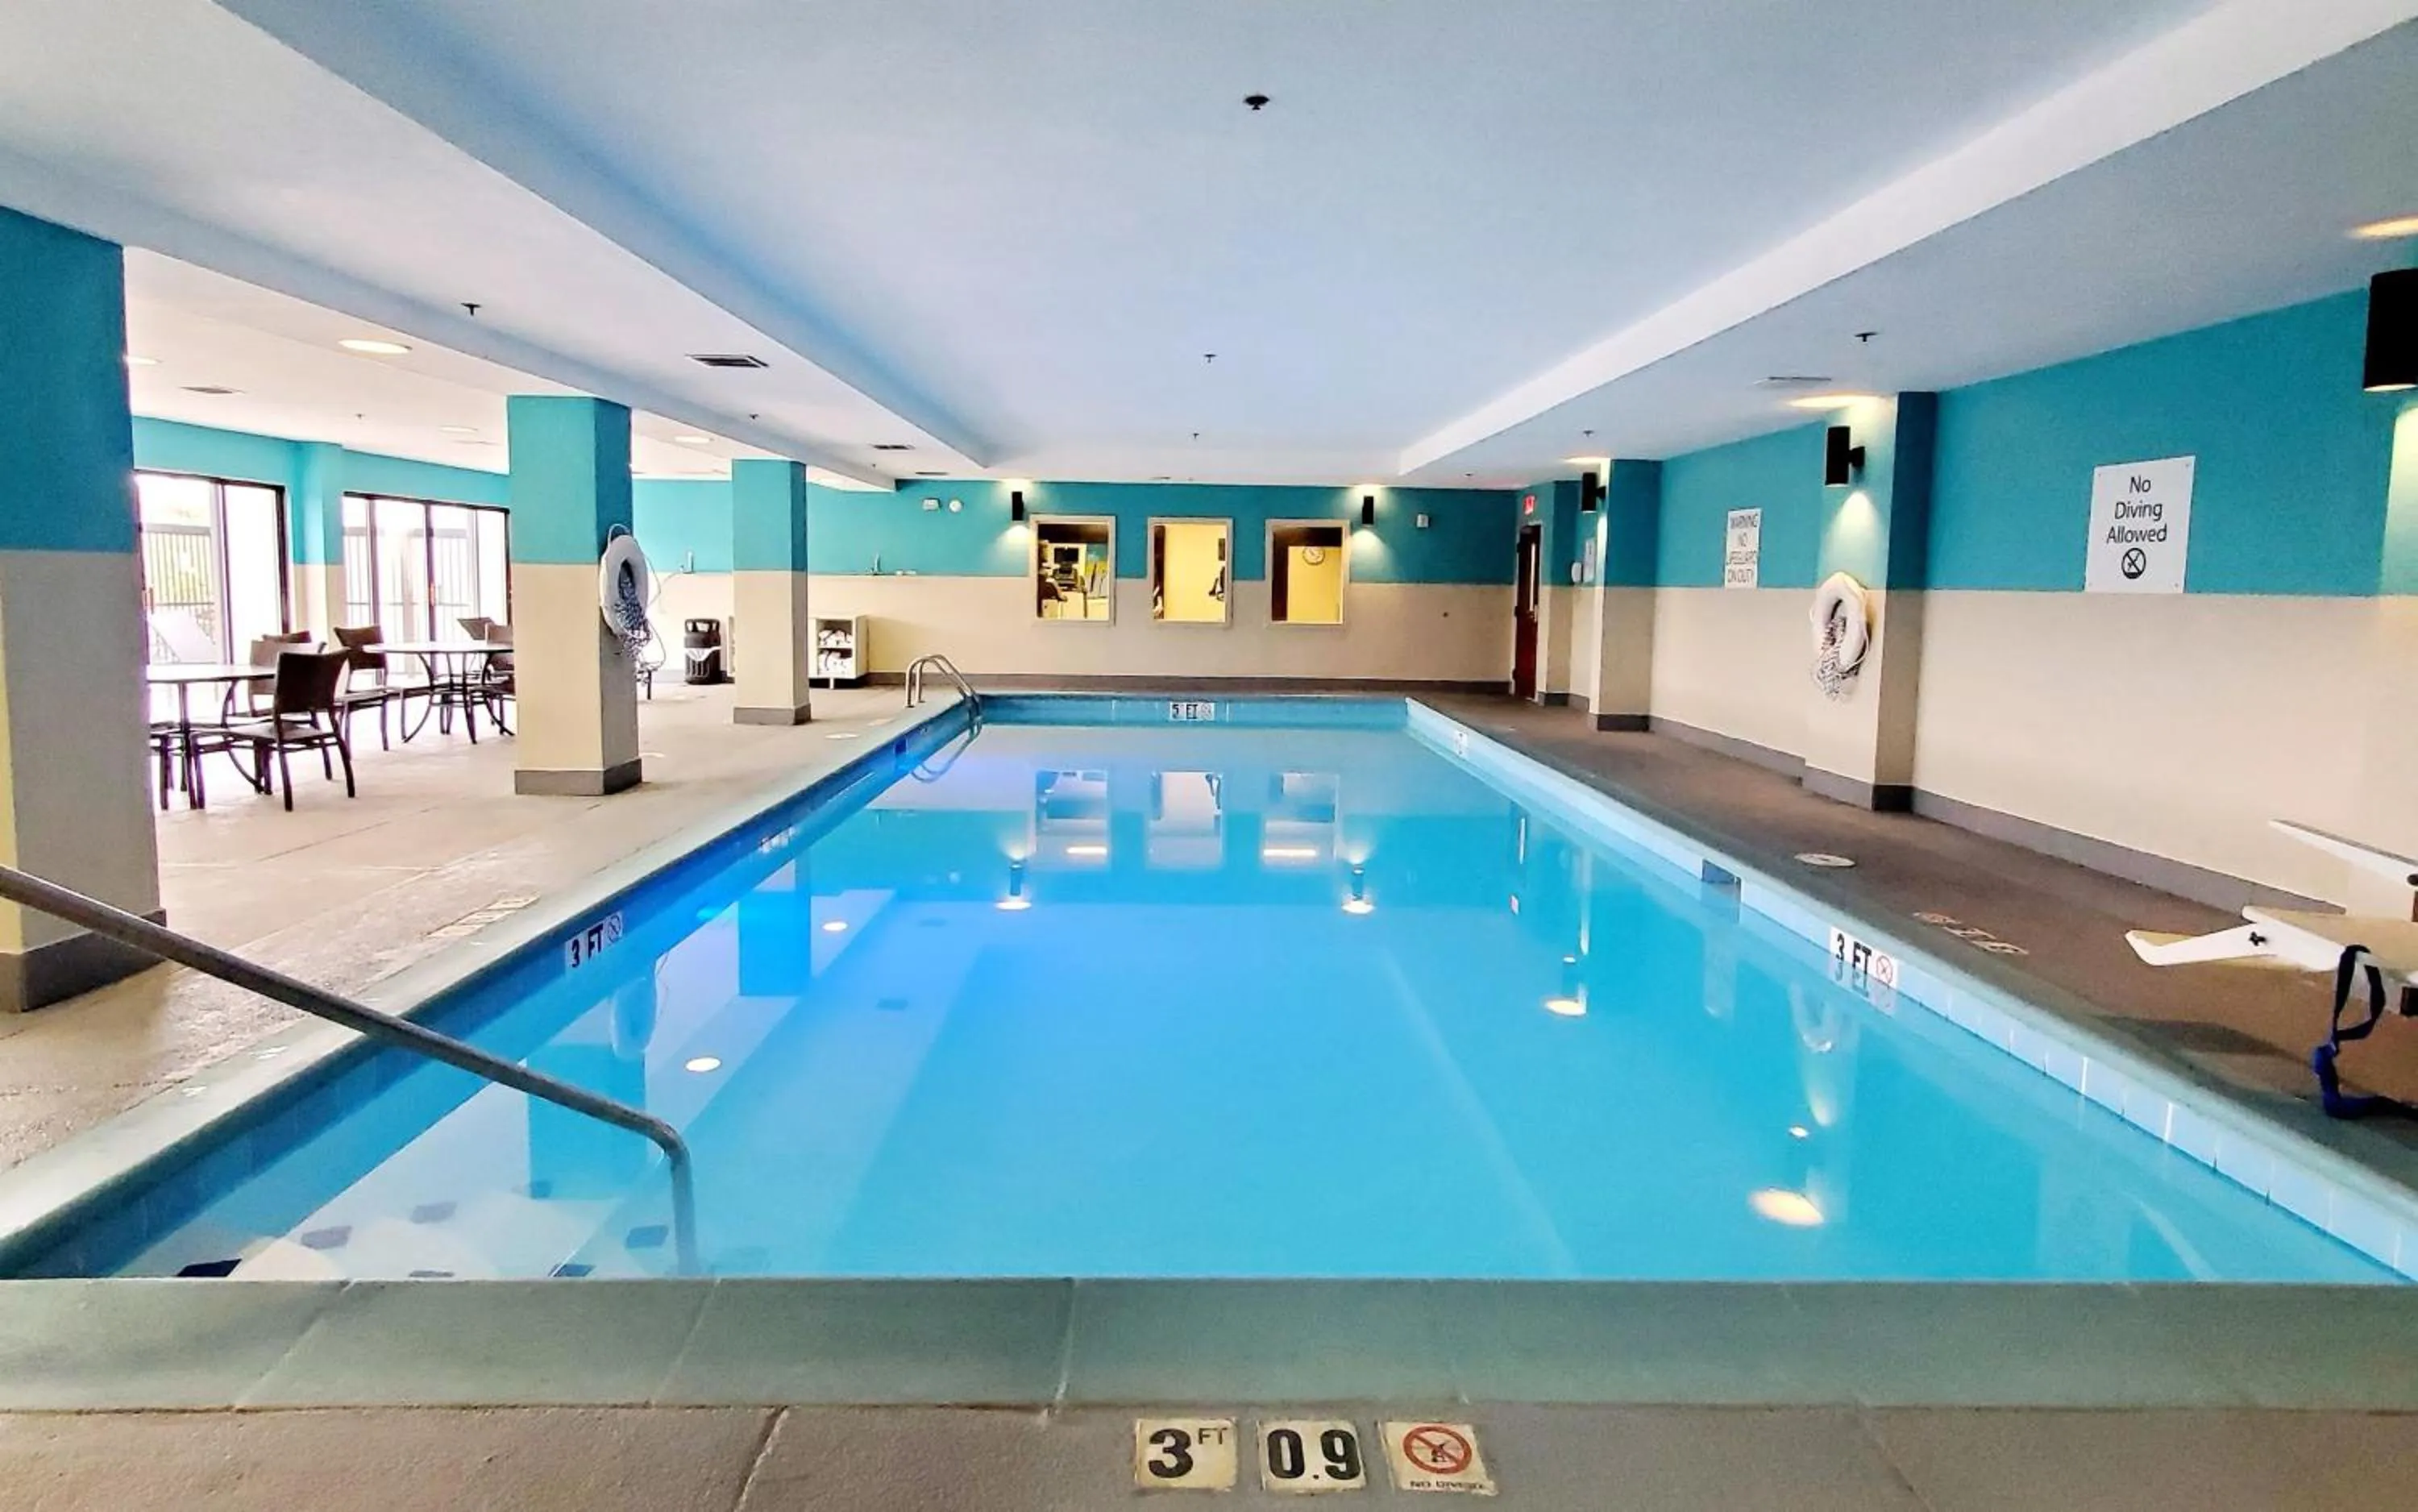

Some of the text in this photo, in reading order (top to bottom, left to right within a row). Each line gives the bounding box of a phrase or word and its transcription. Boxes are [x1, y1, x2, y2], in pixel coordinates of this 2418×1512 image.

[2129, 475, 2151, 493] No
[2114, 500, 2163, 521] Diving
[2106, 523, 2167, 544] Allowed
[1171, 704, 1179, 719] 5
[571, 922, 604, 968] 3 FT
[1836, 933, 1872, 974] 3 FT
[1148, 1427, 1228, 1479] 3 FT
[1267, 1428, 1361, 1481] 0.9
[1410, 1481, 1431, 1489] NO
